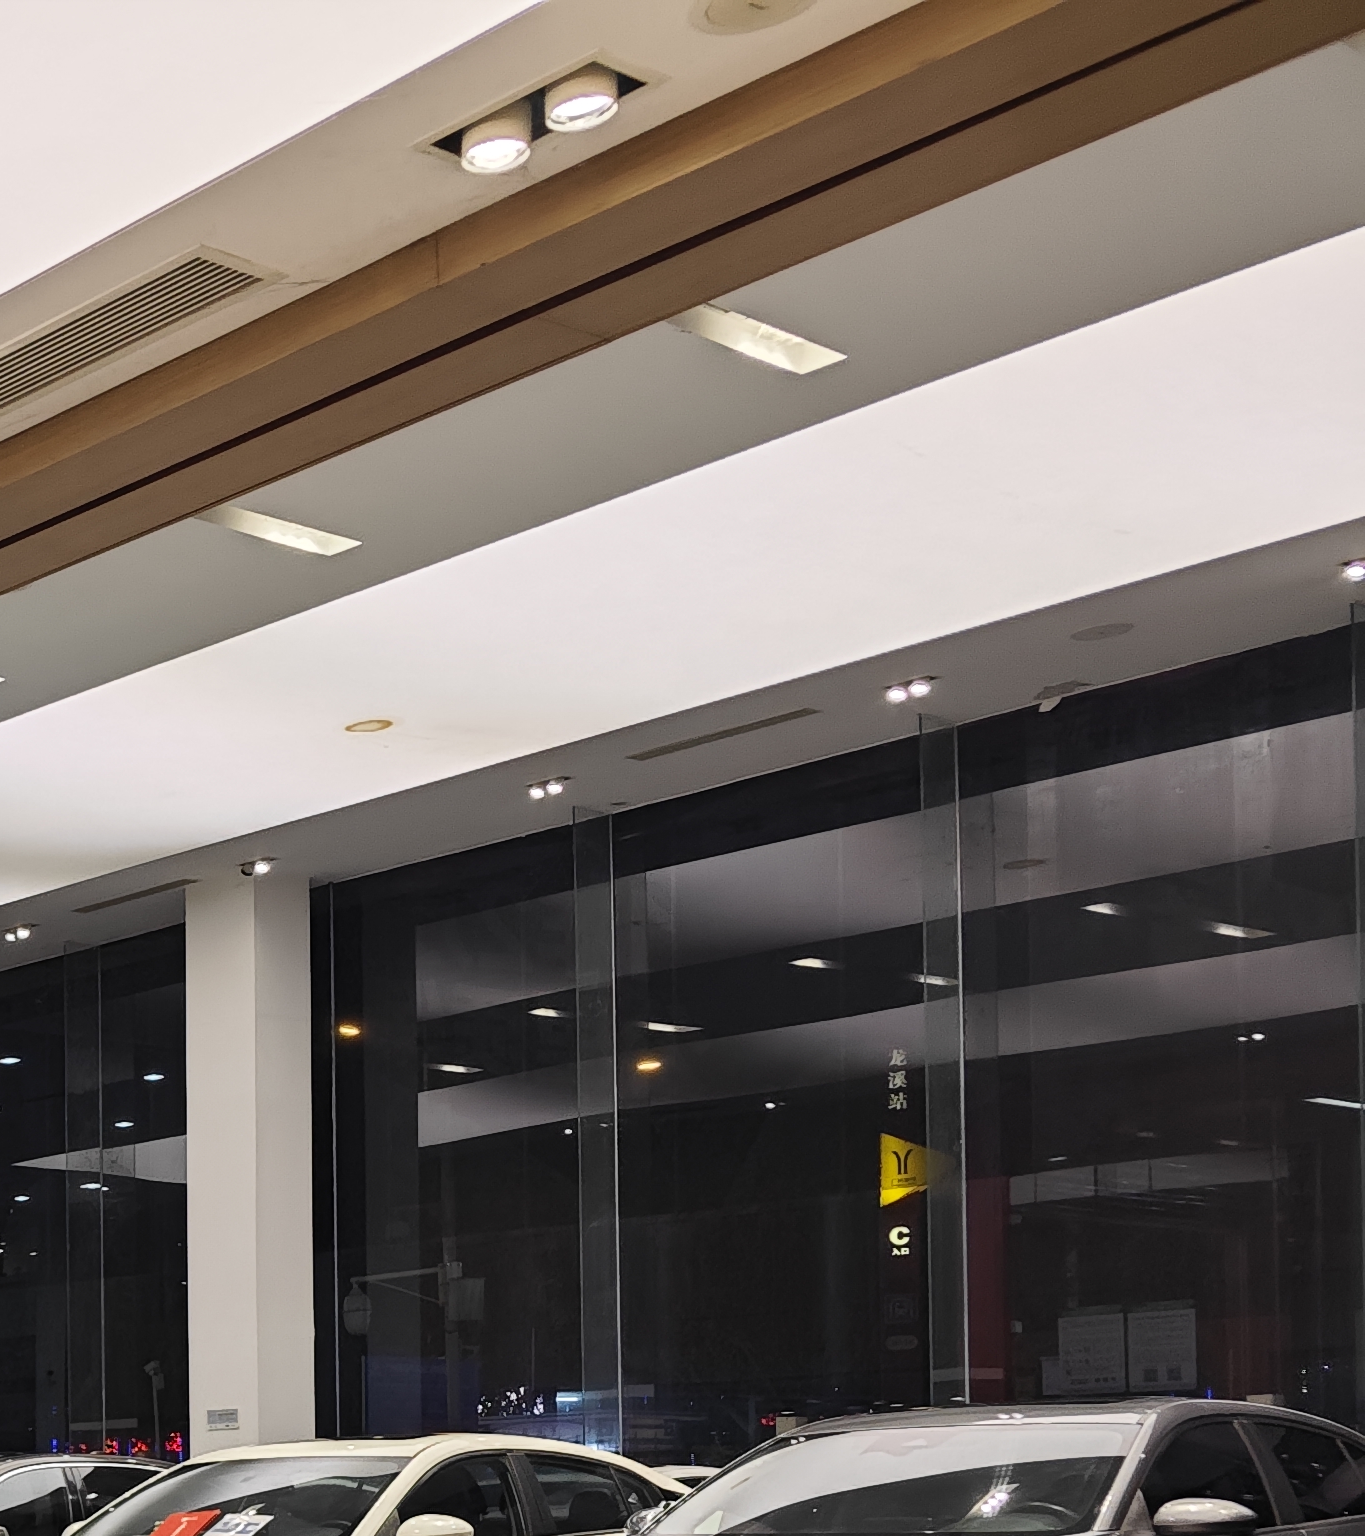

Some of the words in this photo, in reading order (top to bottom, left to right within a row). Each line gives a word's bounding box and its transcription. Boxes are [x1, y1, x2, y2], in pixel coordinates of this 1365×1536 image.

[887, 1048, 908, 1111] 龙溪站
[888, 1225, 911, 1246] C
[891, 1247, 910, 1257] 入口
